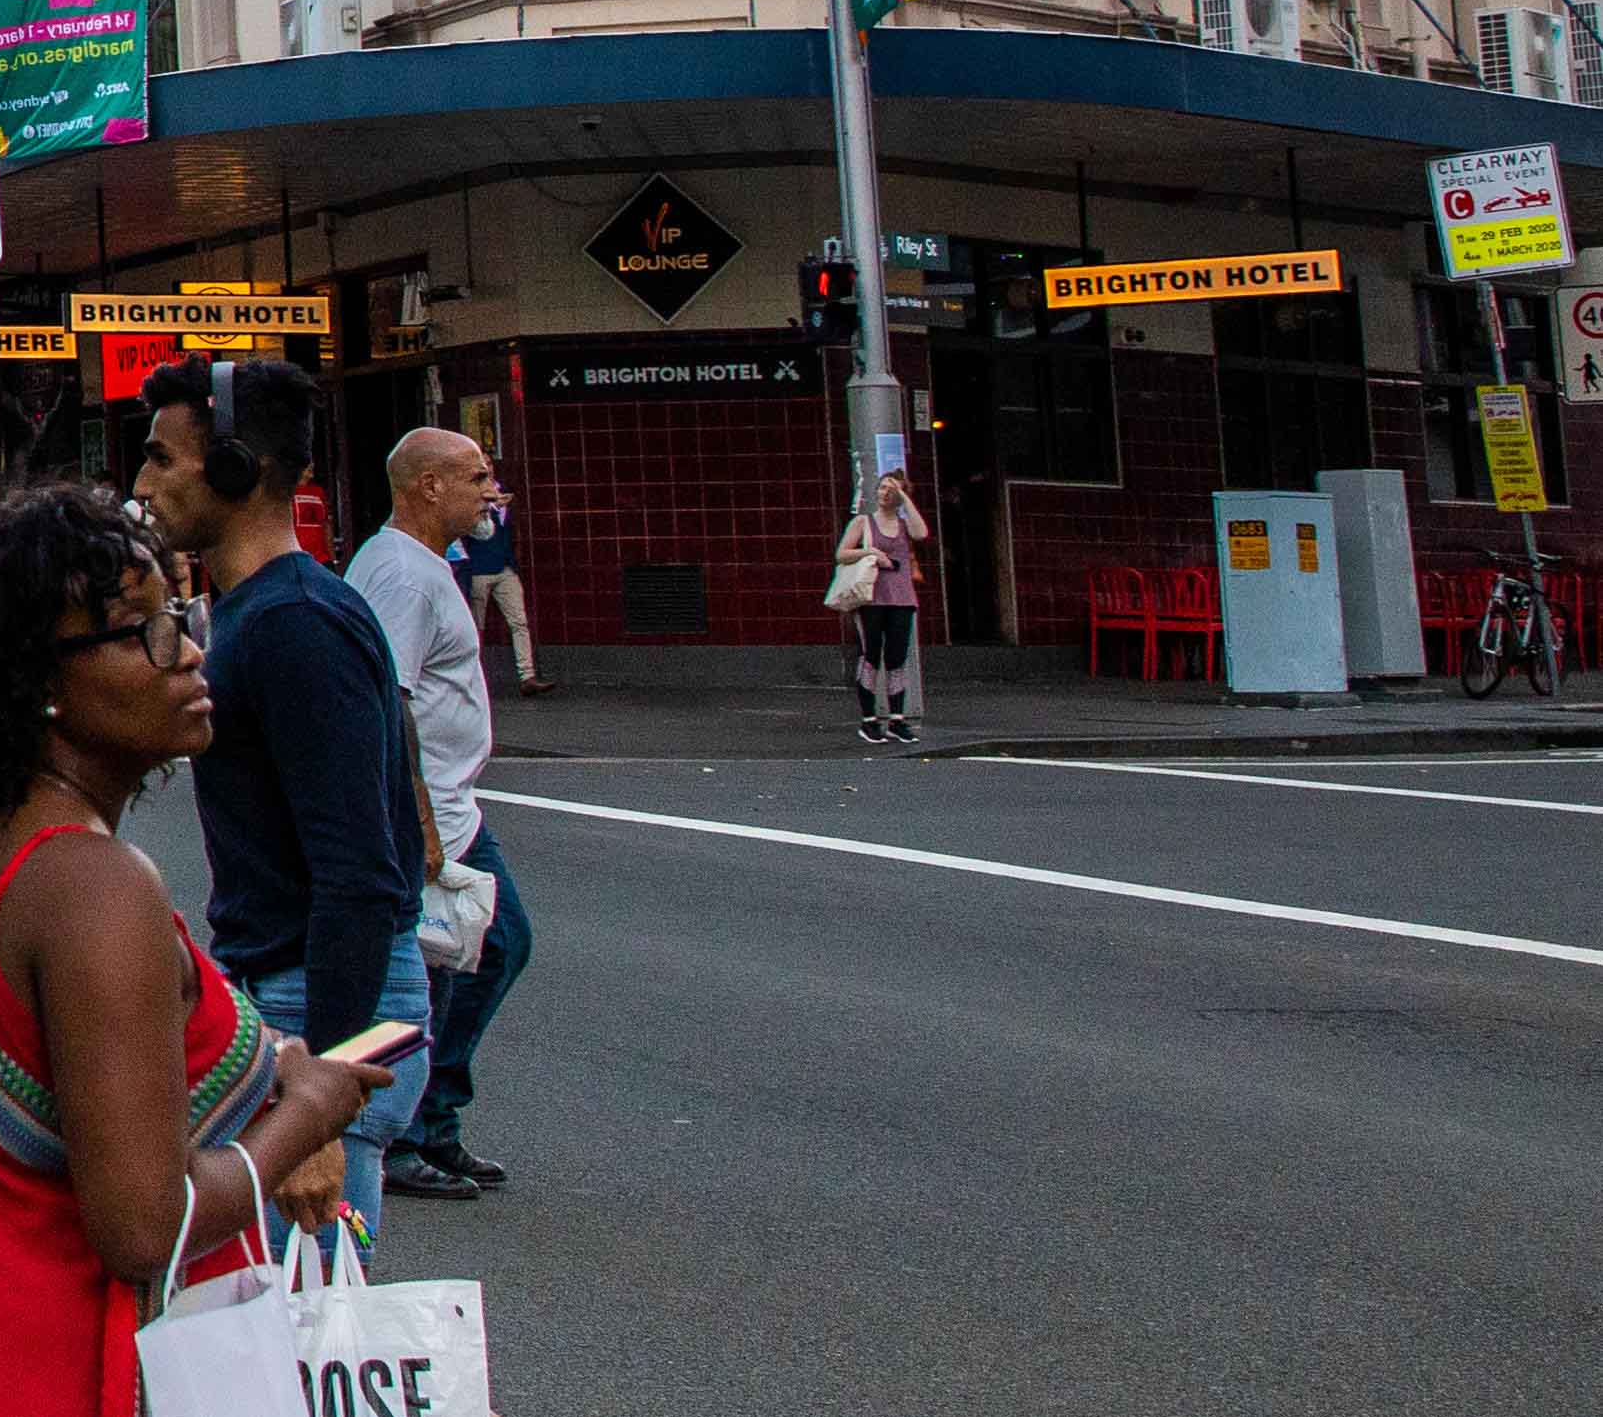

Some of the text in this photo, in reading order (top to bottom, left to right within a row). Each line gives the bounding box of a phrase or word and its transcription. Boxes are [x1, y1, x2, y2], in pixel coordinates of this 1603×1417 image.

[1436, 150, 1542, 175] CLEARWAY
[1441, 166, 1546, 189] SPECIAL EVENT
[1450, 190, 1470, 218] C
[642, 201, 682, 252] VIP
[1481, 230, 1495, 242] 29
[1500, 226, 1523, 238] FEB
[1528, 223, 1556, 234] 2020
[895, 235, 923, 260] Riley
[1496, 246, 1533, 258] MARCH
[1536, 240, 1561, 251] 2020
[618, 253, 710, 272] LOUNGE
[1054, 262, 1329, 298] BRIGHTON HOTEL
[79, 303, 322, 325] BRIGHTON HOTEL
[115, 347, 137, 373] VIP
[584, 364, 763, 385] BRIGHTON HOTEL
[296, 1357, 432, 1417] OSE
